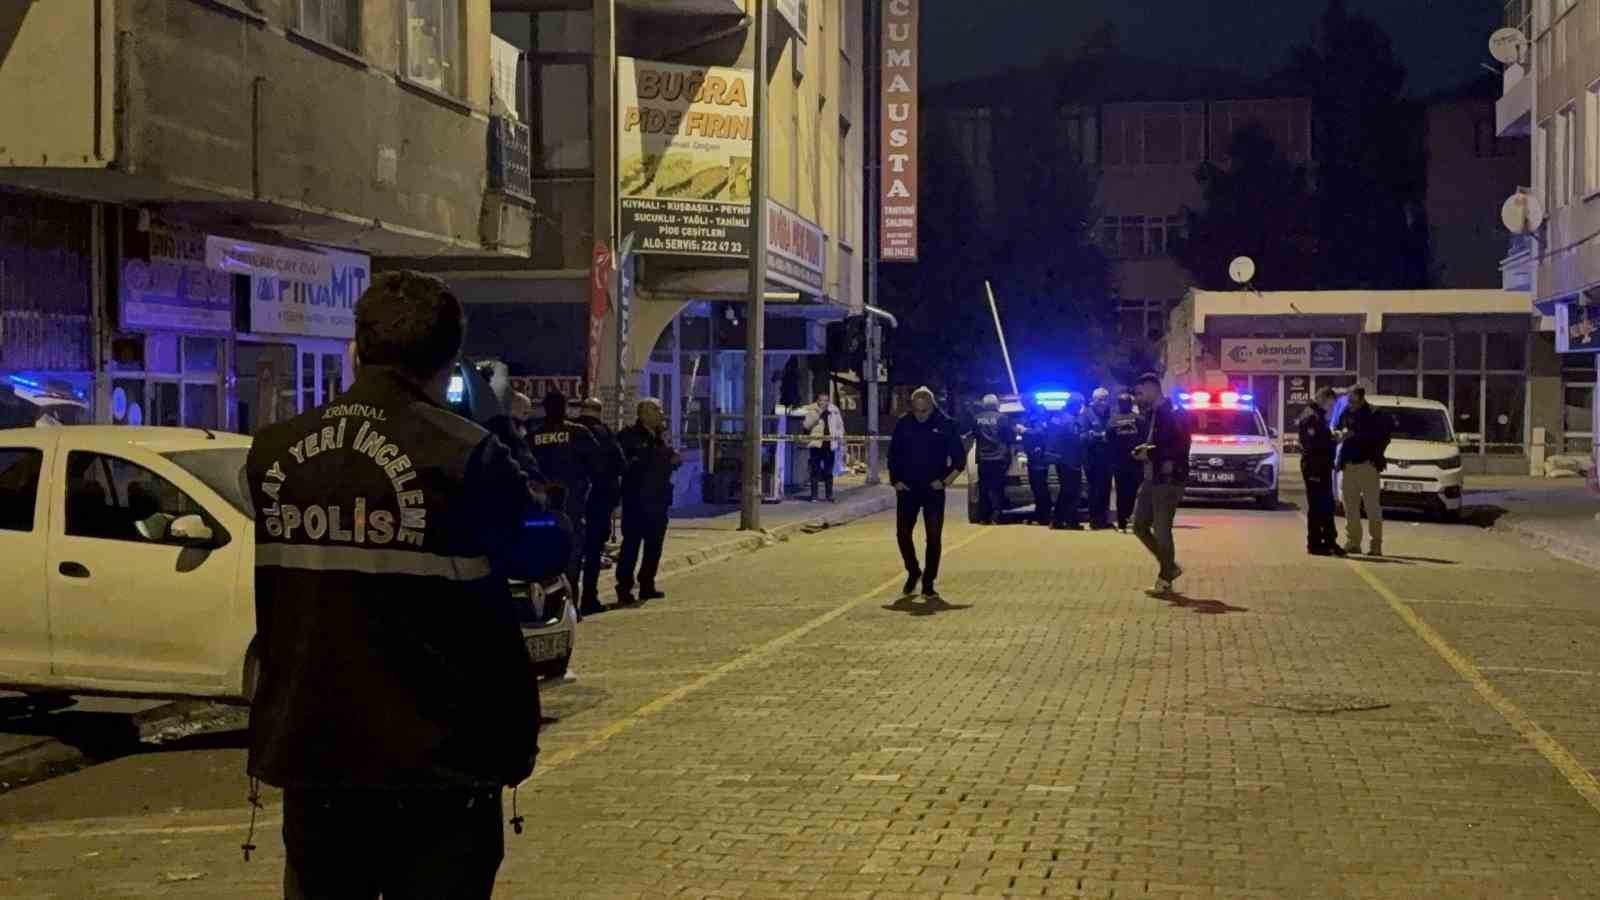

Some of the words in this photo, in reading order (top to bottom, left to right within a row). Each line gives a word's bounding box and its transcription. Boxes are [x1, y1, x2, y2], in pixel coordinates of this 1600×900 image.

[638, 69, 747, 107] BUĞRA
[624, 105, 682, 136] PİDE
[622, 200, 660, 210] KIYMALI
[633, 213, 676, 223] SUCUKLU
[701, 240, 718, 251] 222
[262, 461, 287, 536] OLAY
[288, 417, 348, 464] YERİ
[352, 420, 427, 546] İNCELEME
[281, 497, 396, 544] POLİS
